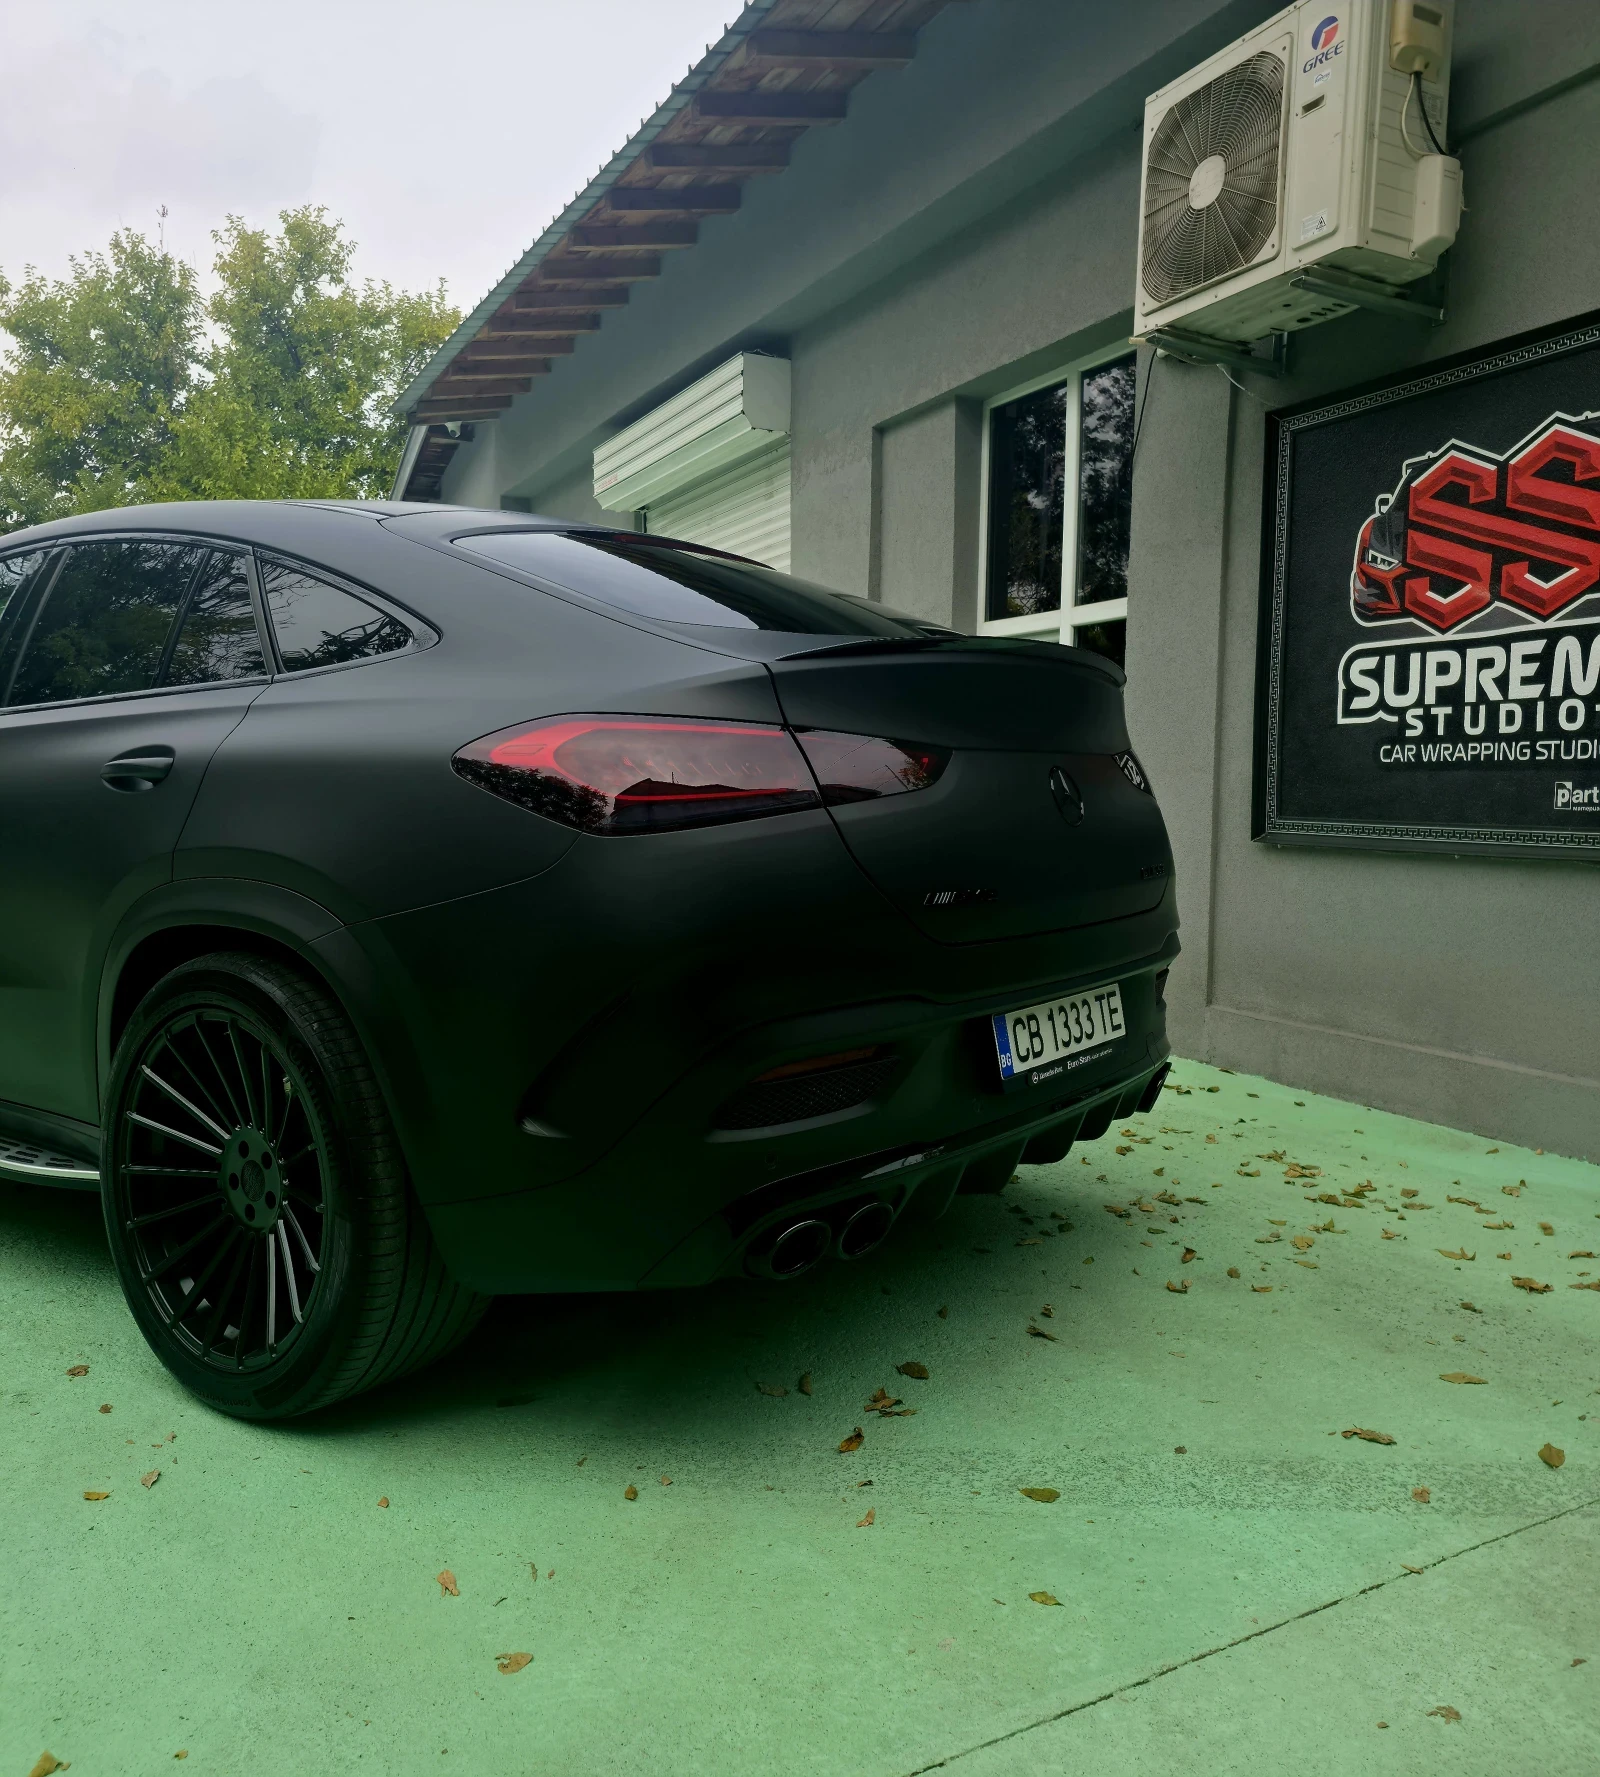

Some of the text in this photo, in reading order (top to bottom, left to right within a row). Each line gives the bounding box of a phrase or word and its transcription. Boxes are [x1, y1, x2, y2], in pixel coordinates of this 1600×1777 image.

[1303, 40, 1344, 73] GREE
[1349, 632, 1600, 710] SUPREM
[1380, 739, 1600, 763] CAR WRAPPING STUDI
[1012, 990, 1122, 1063] CB 1333 TE
[1001, 1053, 1012, 1068] BG
